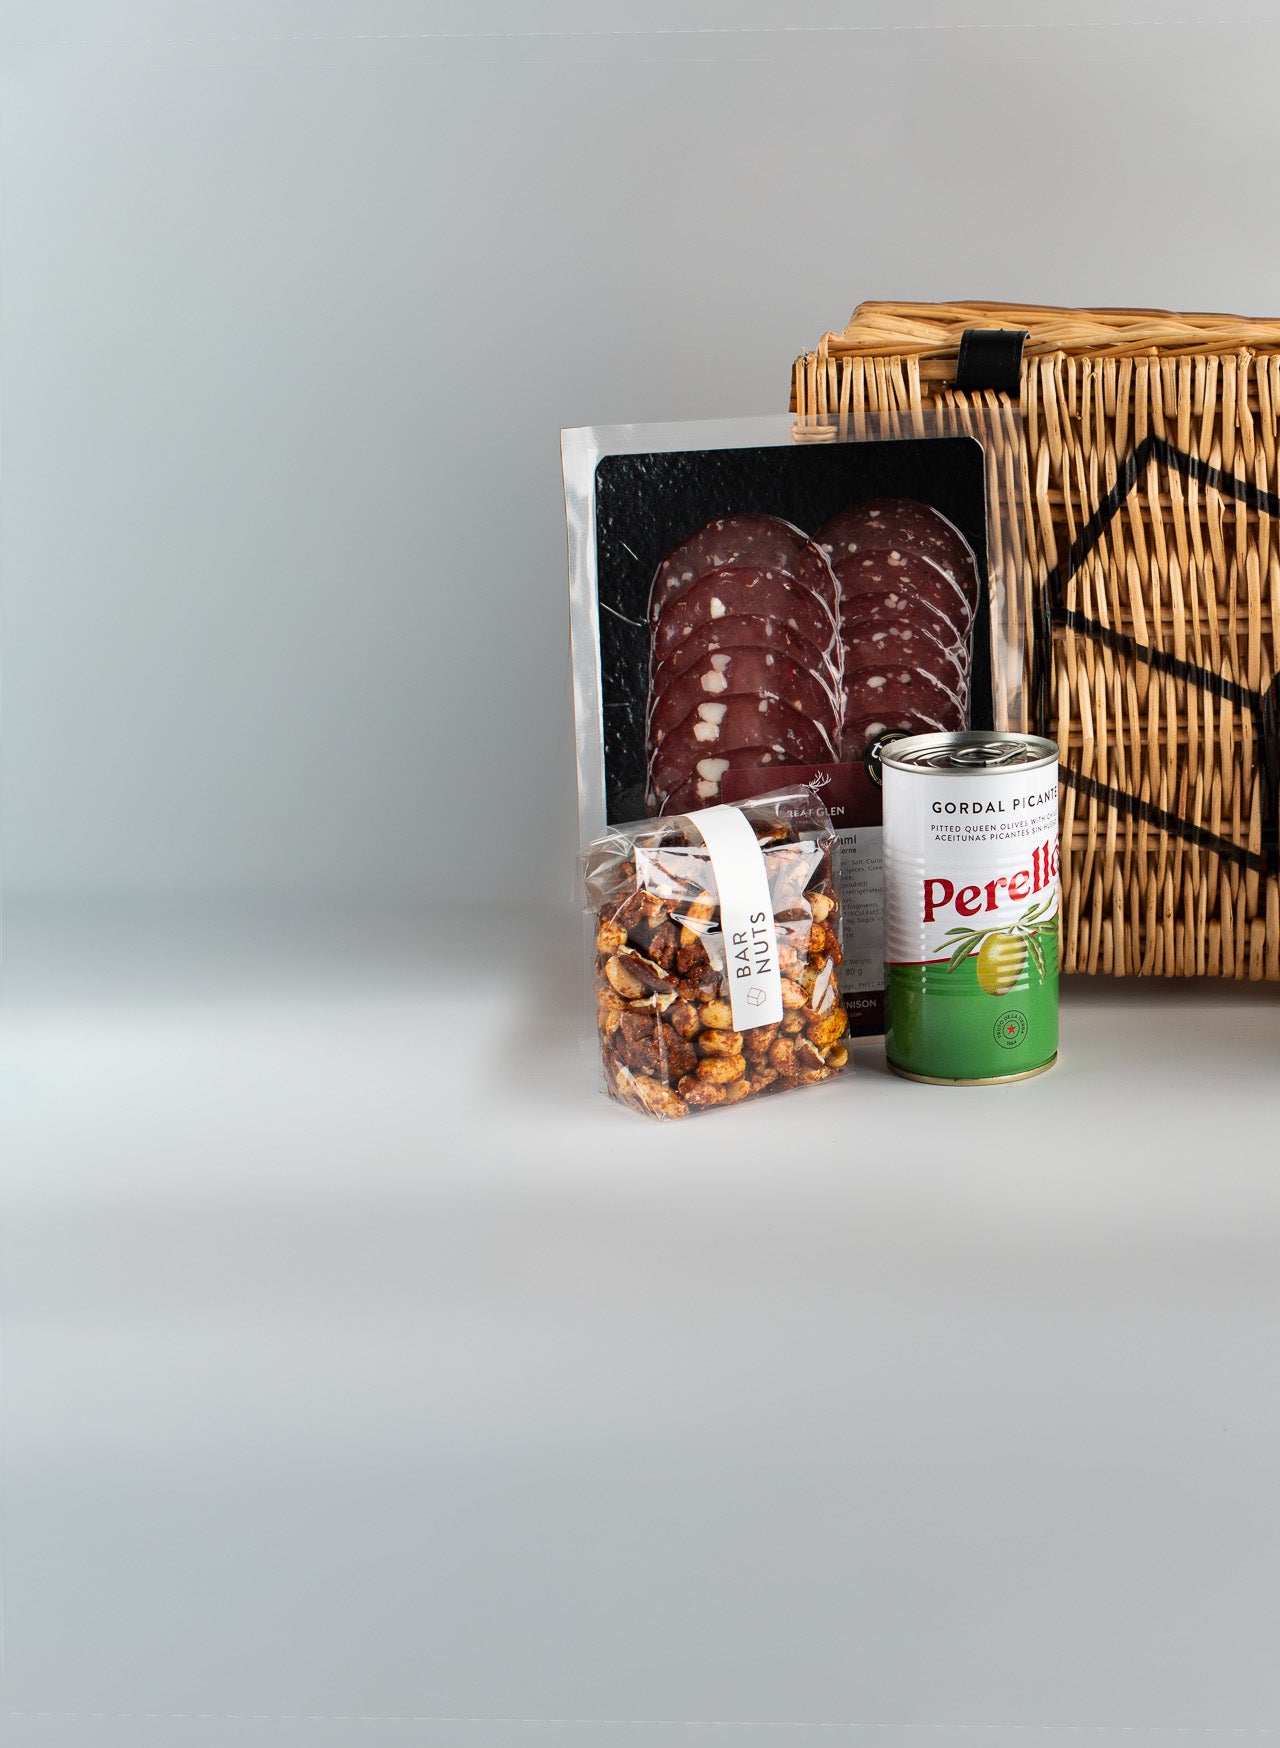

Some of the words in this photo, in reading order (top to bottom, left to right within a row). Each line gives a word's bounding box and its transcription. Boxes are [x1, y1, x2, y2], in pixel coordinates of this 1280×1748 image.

[816, 806, 845, 817] GLEN
[932, 801, 1005, 814] GORDAL
[930, 825, 961, 833] PITTED
[965, 825, 997, 833] QUEEN
[1000, 820, 1028, 830] OLIVES
[1031, 816, 1045, 825] WITH
[935, 834, 986, 842] ACEITUNAS
[990, 829, 1030, 840] PICANTES
[1032, 826, 1042, 834] SIN
[750, 912, 771, 974] NUTS
[732, 931, 751, 979] BAR
[844, 999, 877, 1010] NISON
